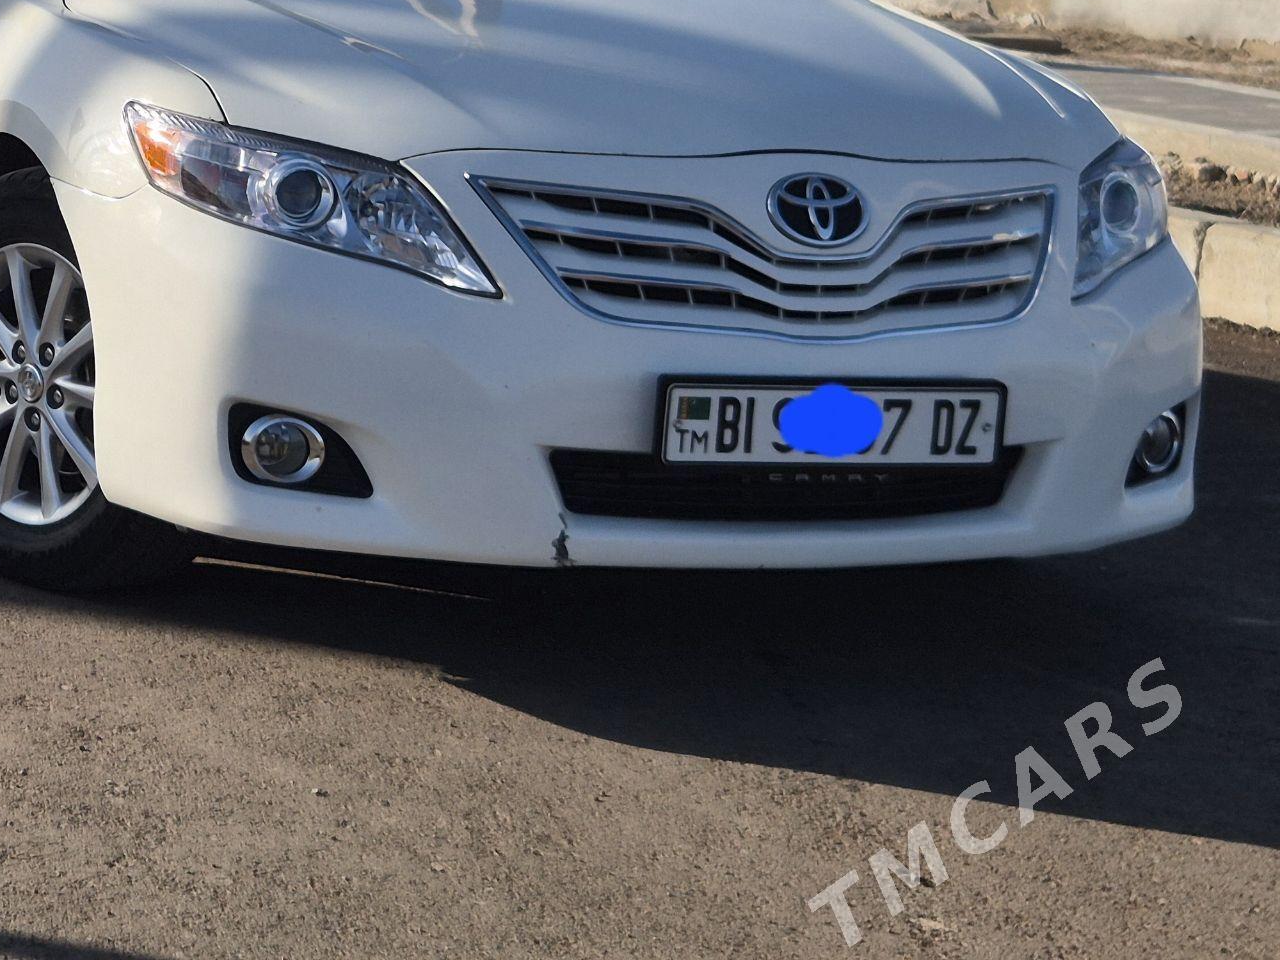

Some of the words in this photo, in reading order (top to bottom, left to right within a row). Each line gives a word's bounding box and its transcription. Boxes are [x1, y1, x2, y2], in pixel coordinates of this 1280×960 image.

[675, 429, 709, 454] TM
[715, 396, 755, 454] BI
[930, 399, 982, 456] DZ
